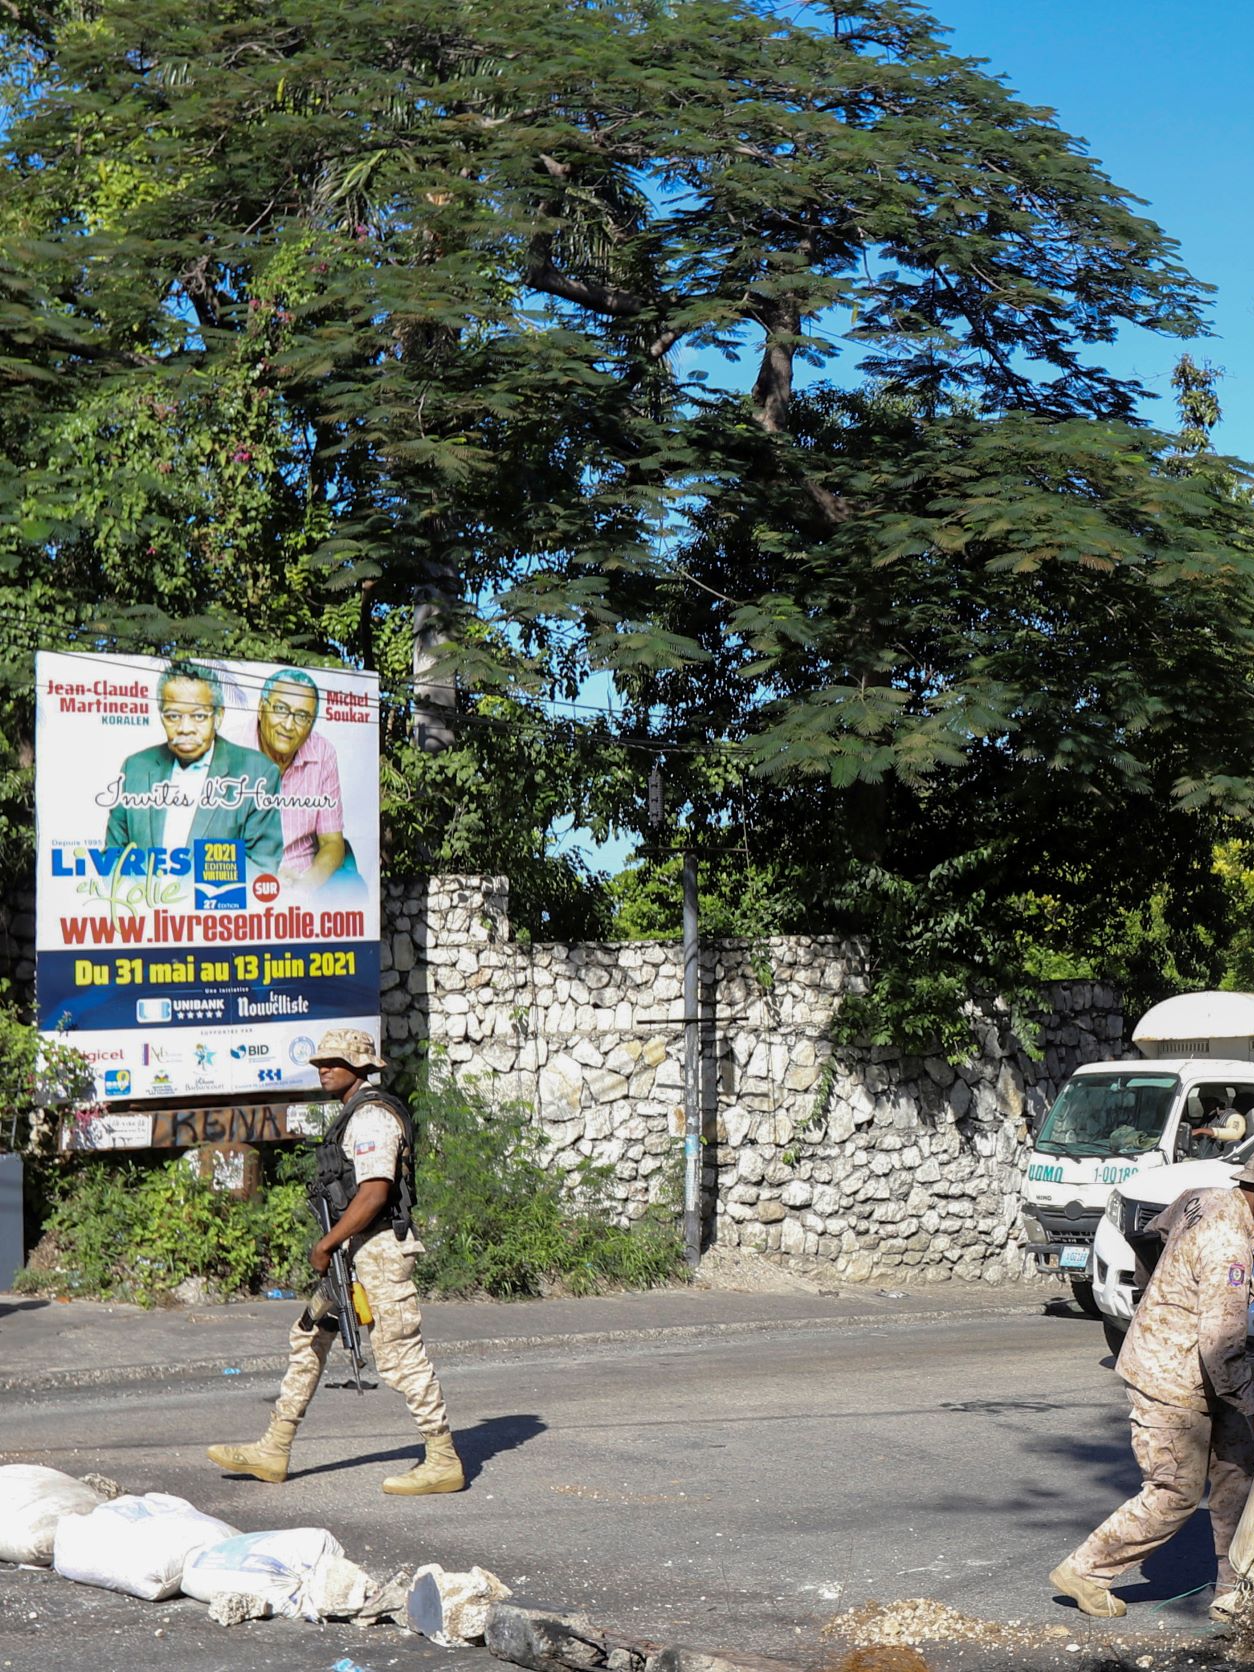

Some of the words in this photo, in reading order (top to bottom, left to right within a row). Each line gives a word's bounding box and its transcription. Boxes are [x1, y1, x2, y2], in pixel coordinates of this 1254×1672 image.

[47, 679, 149, 698] Jean-Claude
[60, 697, 149, 714] Martineau
[326, 691, 368, 707] Michel
[101, 715, 150, 726] KORALEN
[325, 706, 370, 723] Soukar
[95, 776, 194, 808] Invités
[201, 777, 337, 808] d'Honneur
[204, 843, 236, 861] 2021
[205, 862, 237, 872] EDITION
[84, 842, 188, 932] folie
[255, 882, 278, 895] SUR
[60, 907, 364, 944] www.livresenfolie.com
[75, 960, 109, 986] Du
[115, 959, 143, 985] 31
[149, 956, 194, 983] mai
[201, 962, 229, 982] au
[234, 955, 259, 981] 13
[263, 952, 304, 985] juin
[309, 952, 356, 976] 2021
[173, 999, 225, 1011] UNIBANK
[237, 994, 309, 1017] Nouvelliste
[79, 1048, 125, 1063] igicel
[248, 1044, 269, 1056] BID
